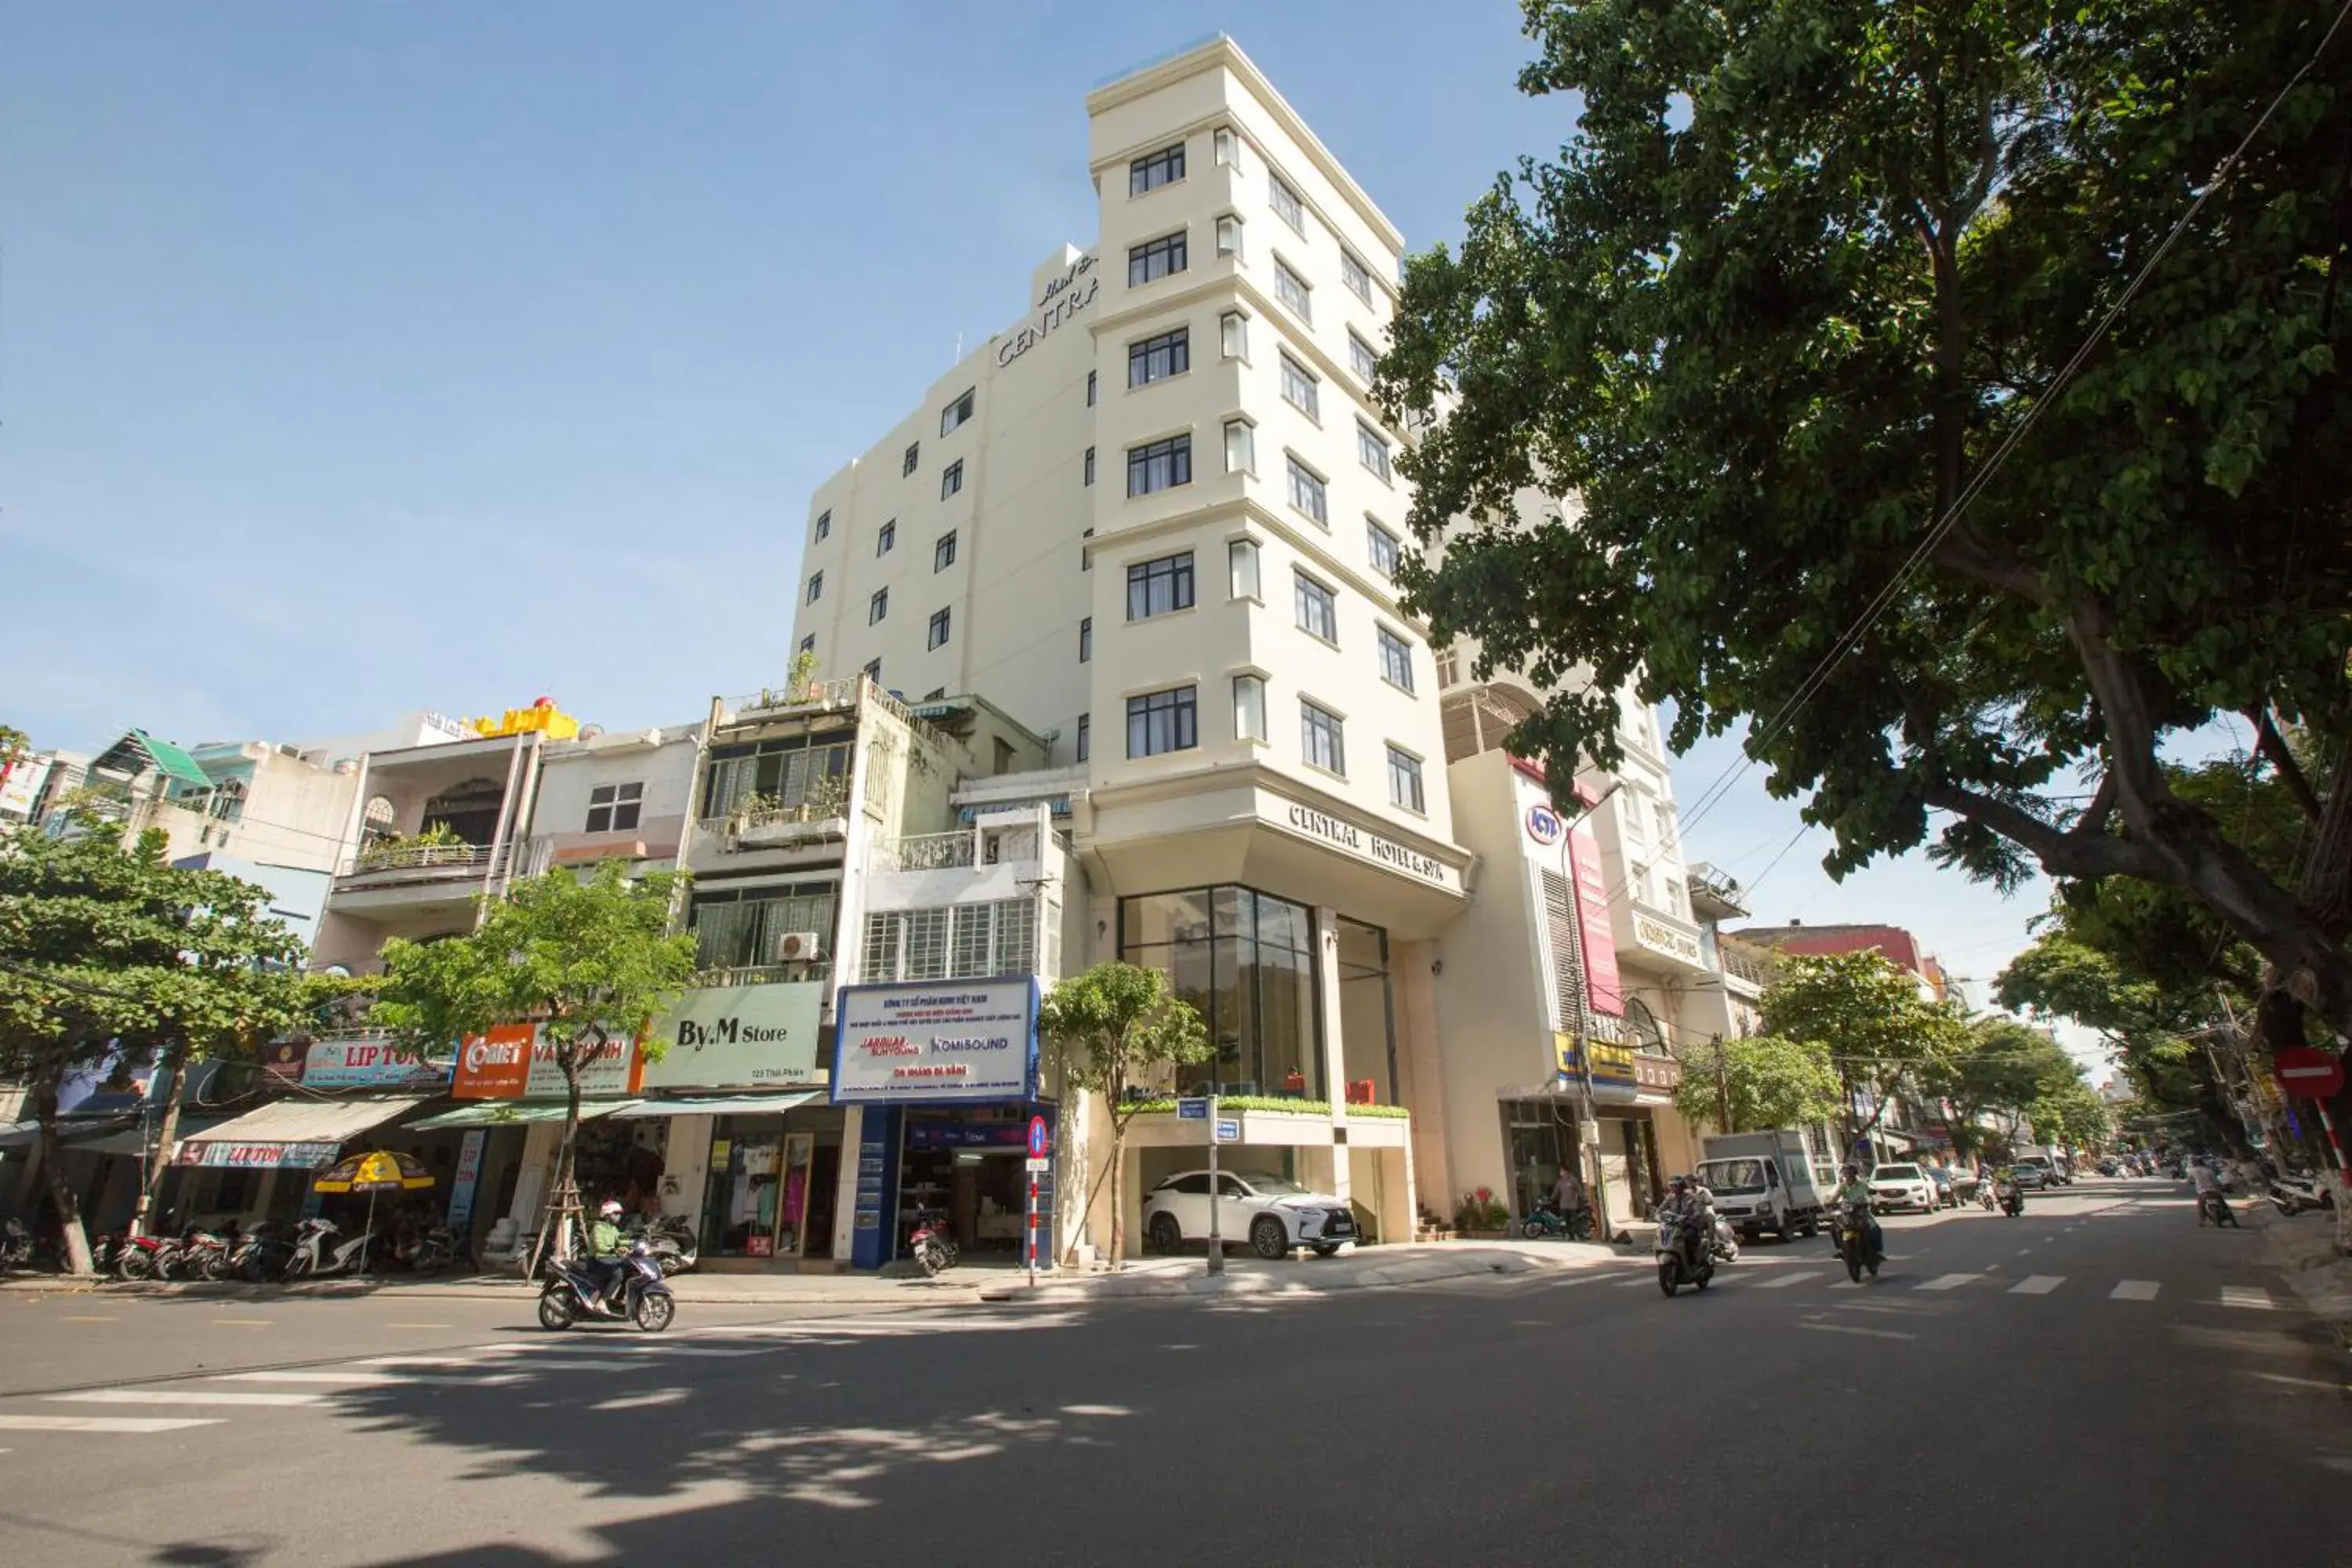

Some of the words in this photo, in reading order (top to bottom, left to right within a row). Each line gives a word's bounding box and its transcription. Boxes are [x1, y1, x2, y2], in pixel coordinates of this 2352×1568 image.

[1289, 804, 1360, 848] CENTRAL
[1371, 836, 1410, 869] HOTEL
[677, 1017, 739, 1051] By.M
[742, 1025, 788, 1043] Store
[344, 1046, 379, 1067] LIP
